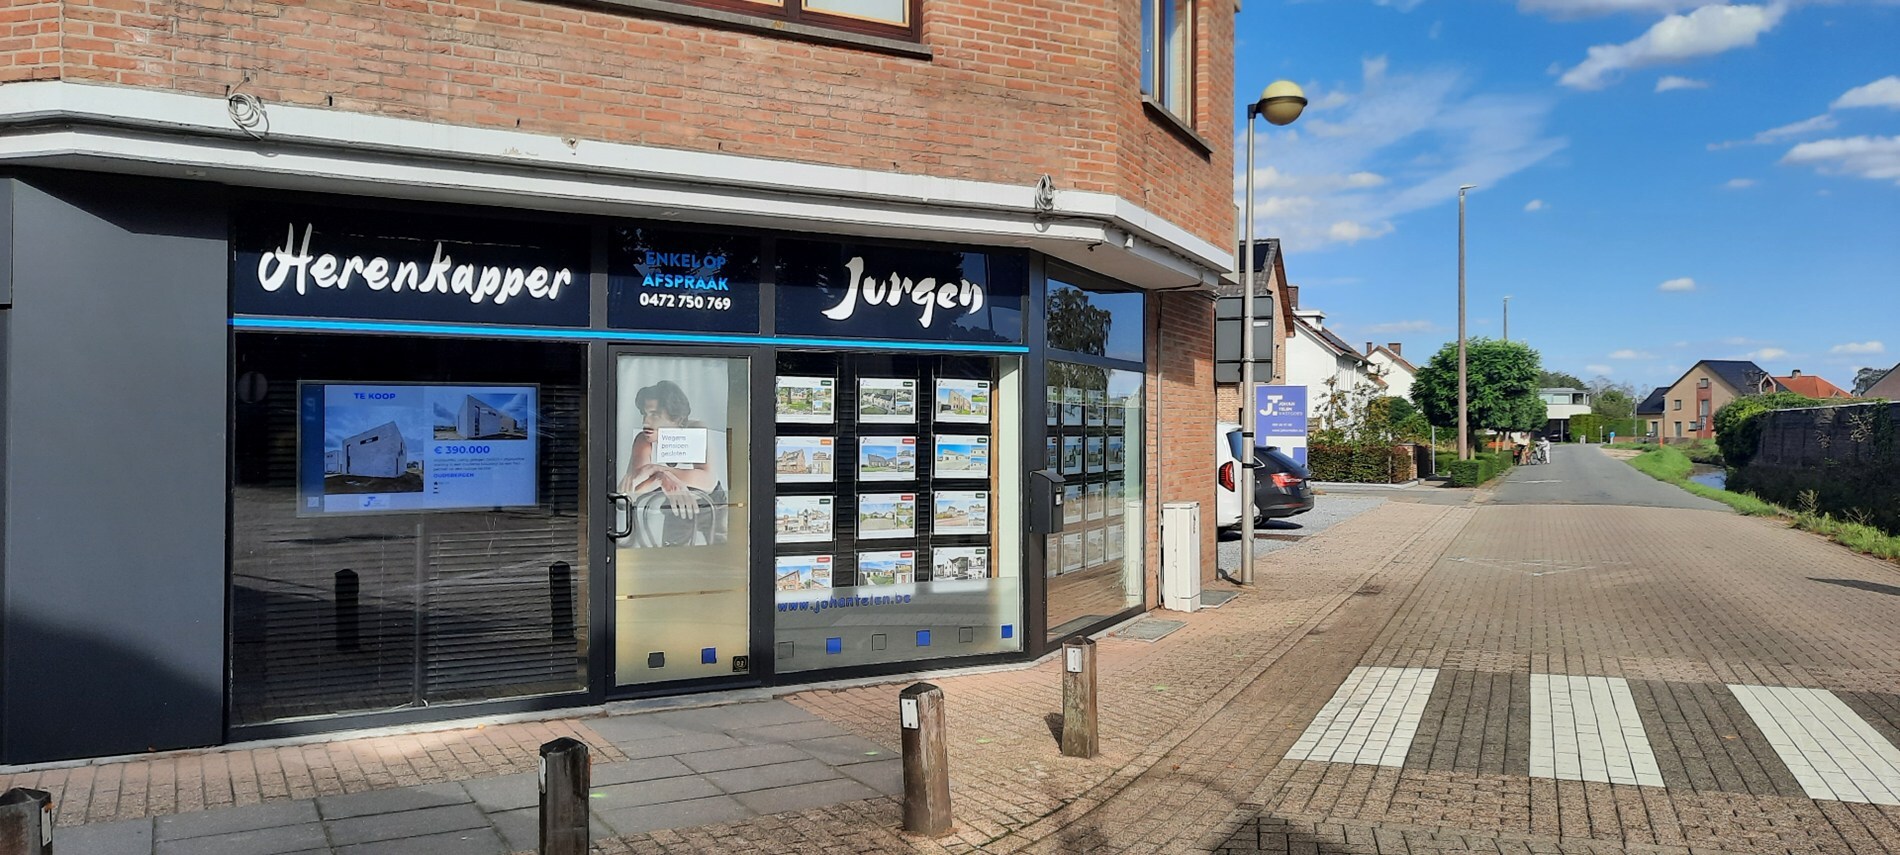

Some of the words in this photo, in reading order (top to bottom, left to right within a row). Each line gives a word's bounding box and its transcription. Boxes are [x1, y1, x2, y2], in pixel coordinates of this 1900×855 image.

[257, 222, 572, 304] Herenkapper
[645, 251, 701, 268] ENKEL
[703, 255, 726, 269] OP
[642, 272, 729, 291] AFSPRAAK
[639, 292, 675, 308] 0472
[677, 294, 704, 309] 750
[706, 296, 731, 311] 769
[821, 256, 984, 328] Jurgen
[353, 392, 366, 400] TE
[368, 392, 396, 400] KOOP
[434, 445, 443, 454] €
[445, 445, 490, 454] 390.000
[777, 592, 912, 614] www.johantelen.be
